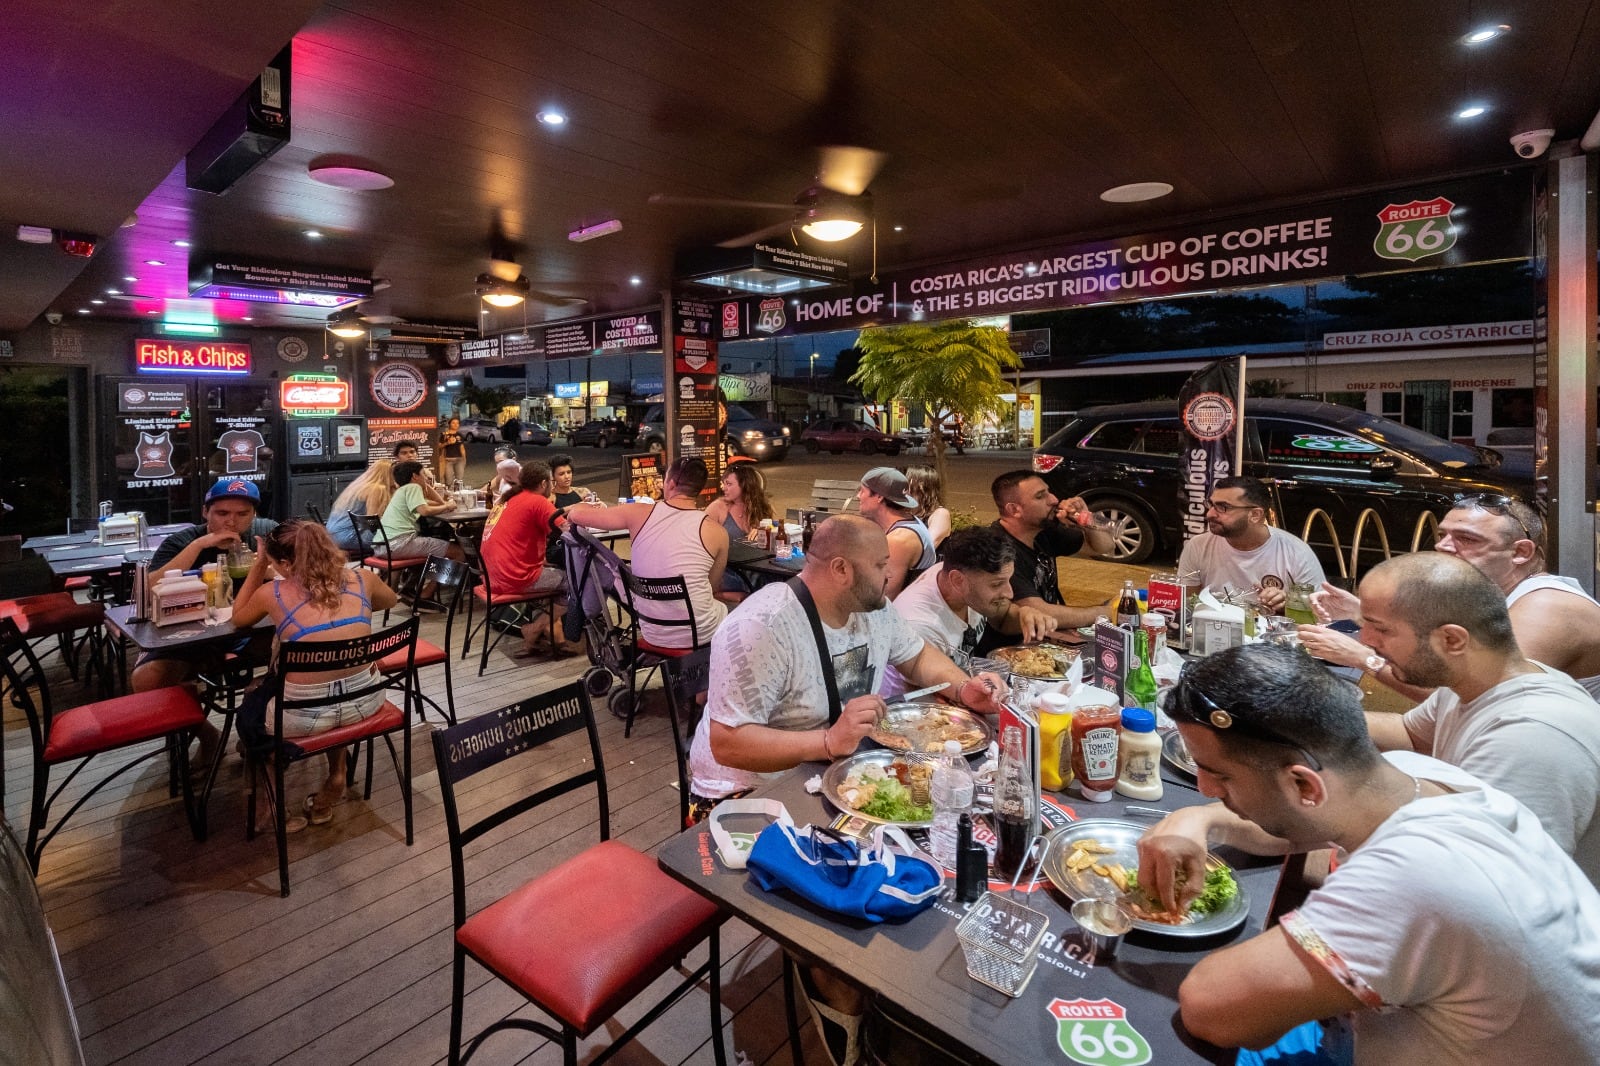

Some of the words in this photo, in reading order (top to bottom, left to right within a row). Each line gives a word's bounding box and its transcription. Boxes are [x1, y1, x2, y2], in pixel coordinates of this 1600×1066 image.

[1388, 204, 1441, 220] ROUTE
[1386, 220, 1444, 254] 66
[755, 243, 764, 251] Get
[776, 248, 800, 258] Ridiculous
[801, 252, 818, 262] Burgers
[818, 256, 833, 264] Limited
[834, 258, 848, 267] Edition
[773, 255, 795, 265] Souvenir
[910, 273, 965, 294] COSTA
[968, 263, 1024, 286] RICA'S
[1029, 248, 1122, 278] LARGEST
[1125, 242, 1176, 264] CUP
[1180, 234, 1217, 256] OF
[1221, 217, 1332, 251] COFFEE
[245, 274, 280, 283] Souvenir
[289, 278, 308, 286] Shirt
[328, 282, 348, 290] NOW!
[250, 266, 291, 276] Ridiculous
[292, 270, 320, 280] Burgers
[320, 273, 346, 282] Limited
[347, 276, 372, 284] Edition
[912, 299, 924, 314] &
[926, 294, 960, 312] THE
[964, 292, 974, 308] 5
[977, 282, 1058, 306] BIGGEST
[1062, 262, 1204, 296] RIDICULOUS
[1210, 246, 1328, 278] DRINKS!
[763, 301, 781, 310] ROUTE
[796, 298, 852, 322] HOME
[855, 294, 884, 315] OF
[610, 317, 636, 328] VOTED
[638, 315, 647, 324] #1
[762, 311, 782, 329] 66
[605, 329, 631, 340] COSTA
[632, 325, 654, 336] RICA
[1326, 335, 1367, 346] CRUZ
[1372, 331, 1414, 344] ROJA
[1419, 324, 1532, 341] COSTARRICE
[462, 340, 490, 350] WELCOME
[602, 339, 622, 350] BEST
[622, 336, 658, 348] BURGER!
[141, 344, 178, 364] Fish
[182, 350, 194, 366] &
[198, 346, 246, 370] Chips
[462, 350, 472, 360] THE
[473, 349, 490, 358] HOME
[490, 348, 499, 356] OF
[1346, 382, 1376, 390] CRUZ
[1379, 381, 1402, 389] ROJ
[1452, 378, 1516, 388] RRICENSE
[302, 438, 318, 449] 66
[370, 429, 428, 446] Featuring
[126, 480, 151, 489] BUY
[152, 478, 183, 487] NOW!
[1183, 448, 1208, 540] idiculous
[648, 584, 683, 594] BURGERS
[1150, 596, 1178, 608] Largest
[286, 646, 364, 664] RIDICULOUS
[366, 626, 412, 655] BURGERS
[726, 622, 773, 718] JUMPMAN
[1092, 732, 1110, 740] HEINZ
[1088, 742, 1114, 751] TOMATO
[697, 832, 710, 857] Garage
[701, 858, 714, 876] Cafe
[1040, 931, 1096, 969] RICA
[1058, 1005, 1116, 1016] ROUTE
[1071, 1022, 1138, 1058] 66
